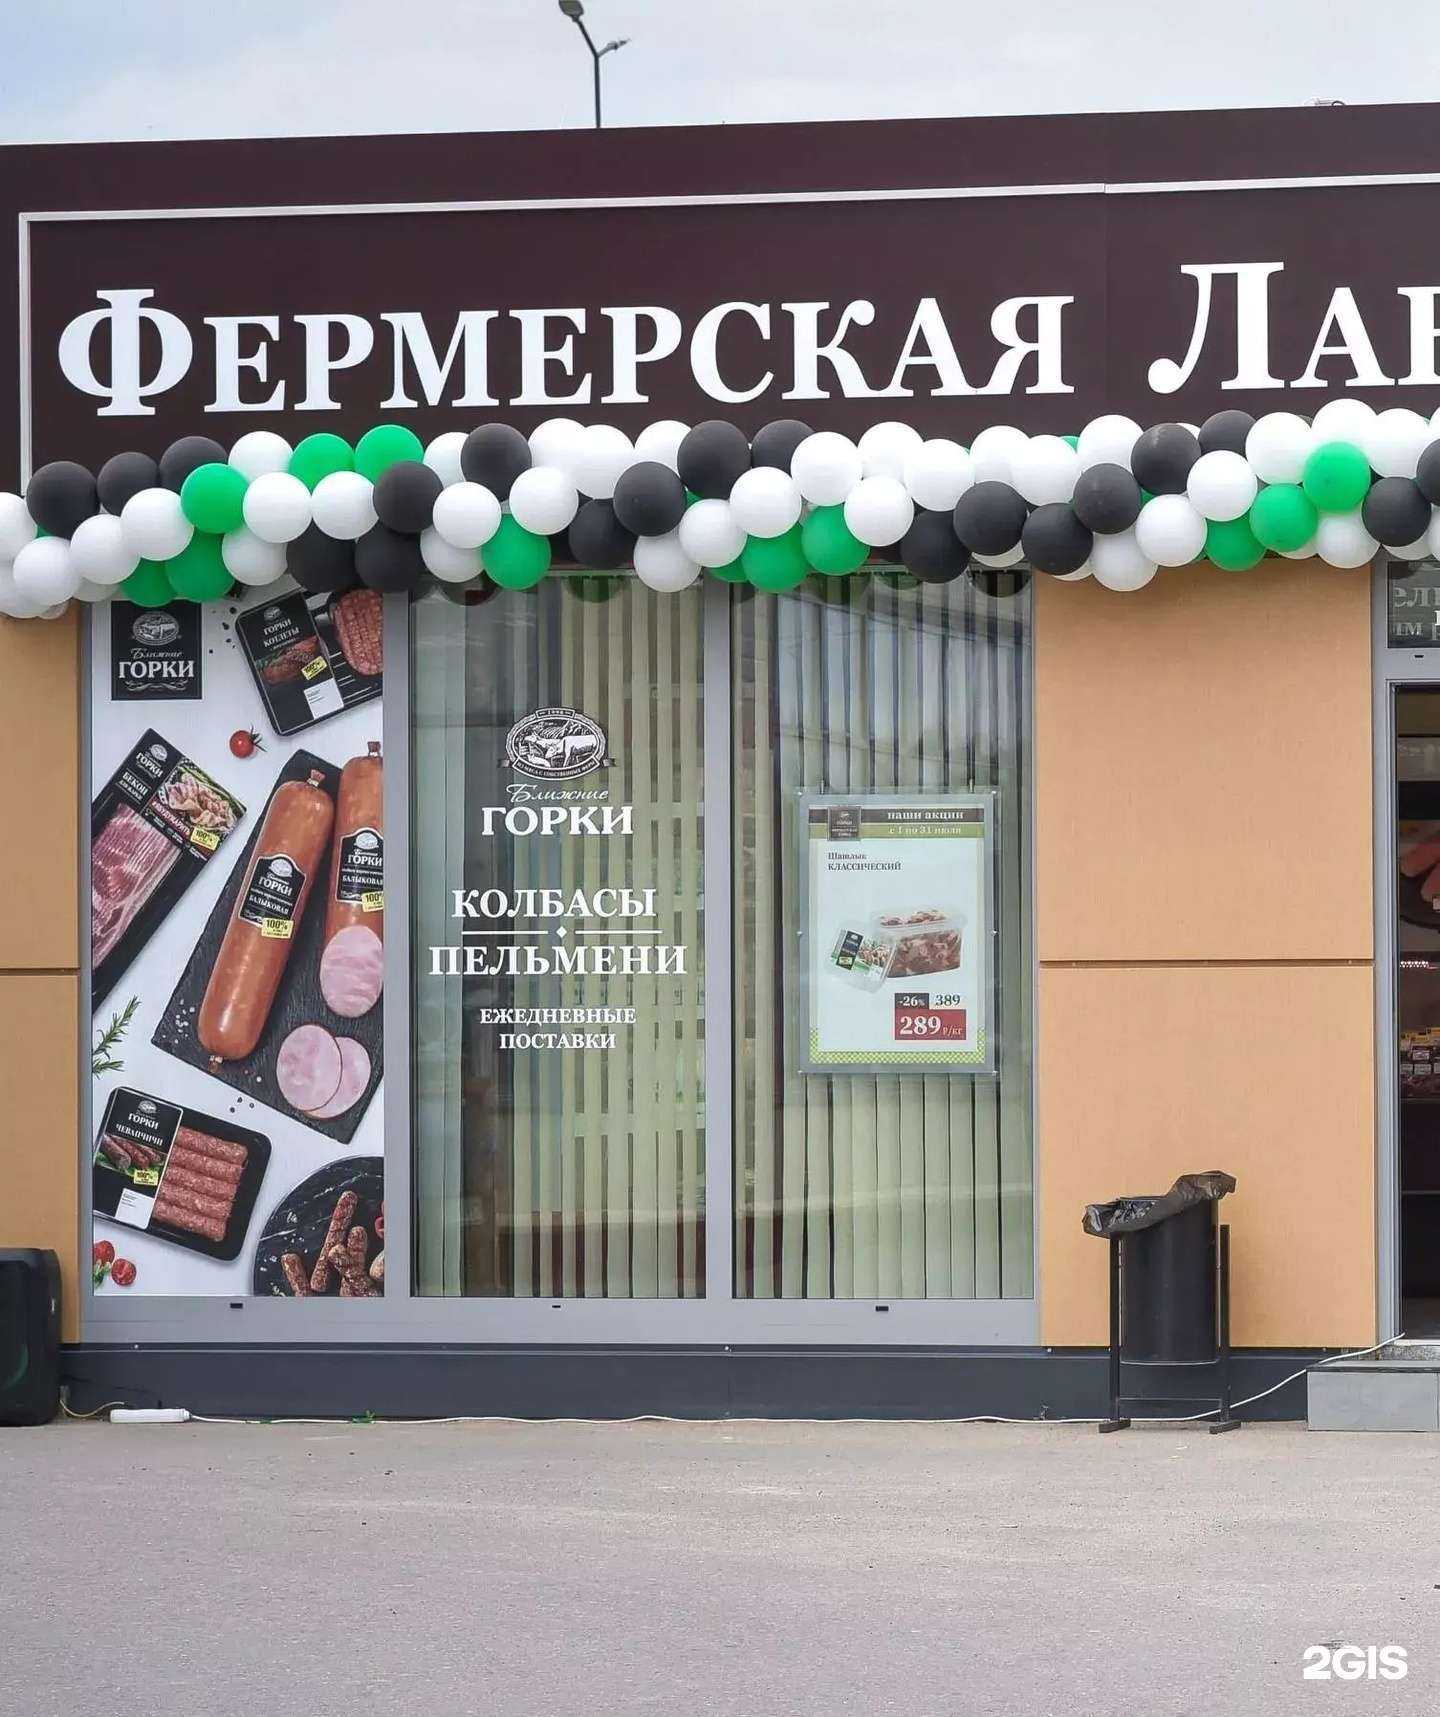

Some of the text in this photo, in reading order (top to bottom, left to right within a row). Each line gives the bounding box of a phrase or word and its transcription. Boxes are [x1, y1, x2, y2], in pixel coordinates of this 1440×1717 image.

[58, 288, 1075, 416] ФЕРМЕРСКАЯ
[118, 660, 195, 679] ГОРКИ
[135, 753, 164, 778] ГОРКИ
[506, 783, 609, 803] Ближние
[481, 806, 634, 836] ГОРКИ
[887, 810, 964, 822] наши акции
[347, 854, 383, 868] ГОРКИ
[828, 861, 902, 871] КЛАССИЧЕСКИЙ
[258, 876, 293, 896] ГОРКИ
[451, 888, 657, 918] КОЛБАСЫ
[266, 918, 288, 931] 100%
[428, 945, 688, 976] ПЕЛЬМЕНИ
[935, 993, 961, 1007] 389
[479, 1008, 637, 1026] ЕЖЕДНЕВНЫЕ
[899, 1015, 942, 1036] 289
[499, 1033, 617, 1049] ПОСТАВКИ
[128, 1113, 160, 1130] ГОРКИ
